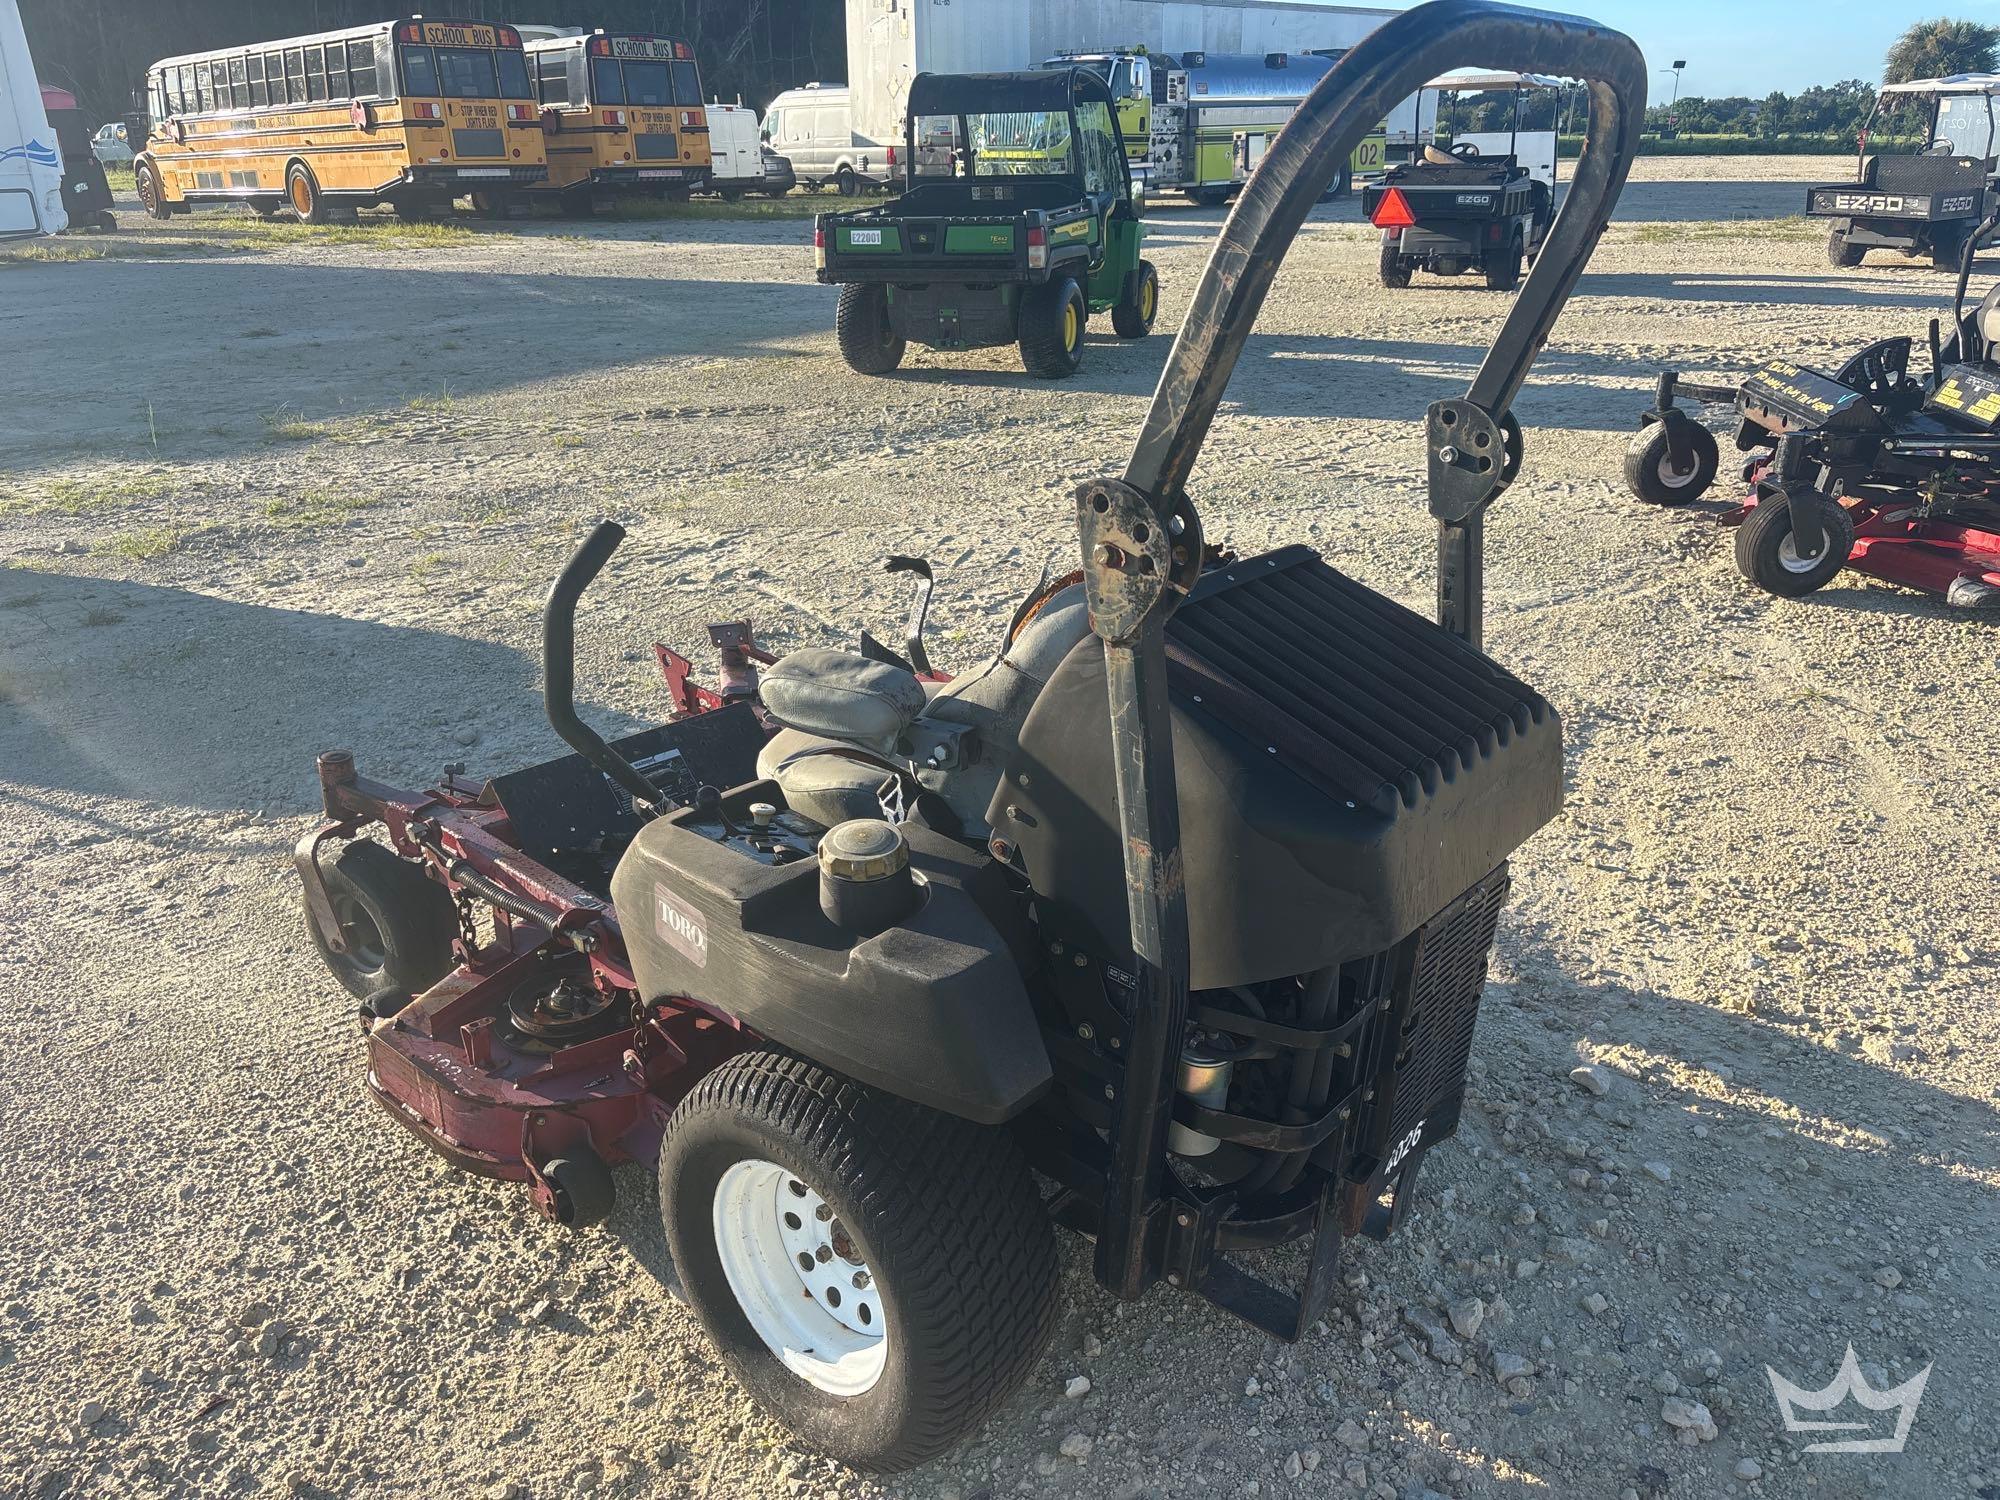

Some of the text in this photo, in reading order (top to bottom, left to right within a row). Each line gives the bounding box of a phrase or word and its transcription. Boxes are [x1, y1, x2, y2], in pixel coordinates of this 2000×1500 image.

[428, 27, 492, 44] SCHOOL BUS
[616, 41, 670, 56] SCHOOL BUS
[1360, 143, 1378, 166] 02
[852, 232, 880, 243] E22001
